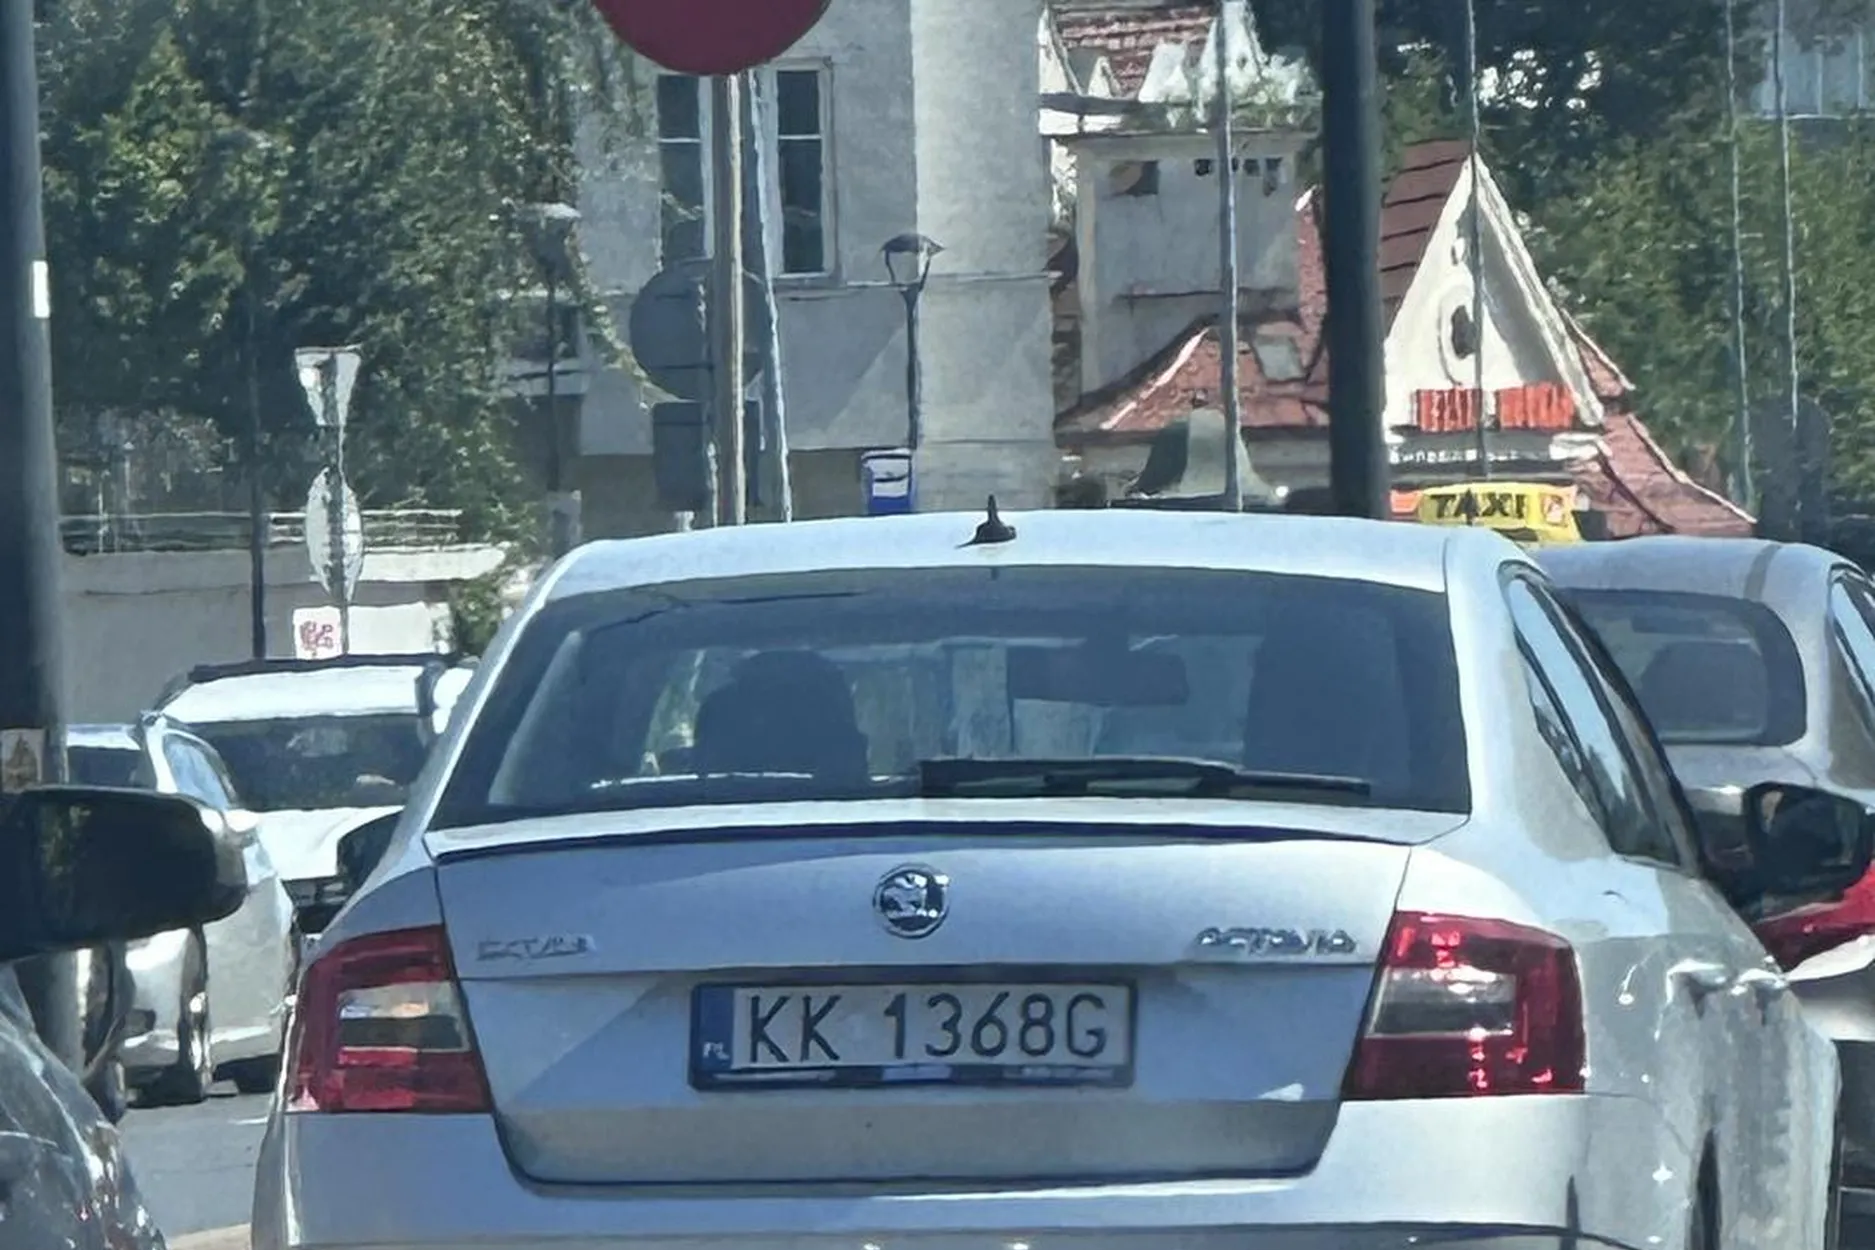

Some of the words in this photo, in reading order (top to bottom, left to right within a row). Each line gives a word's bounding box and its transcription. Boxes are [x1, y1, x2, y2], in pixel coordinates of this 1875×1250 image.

[1430, 493, 1528, 520] TAXI
[750, 994, 842, 1063] KK
[883, 991, 1107, 1060] 1368G
